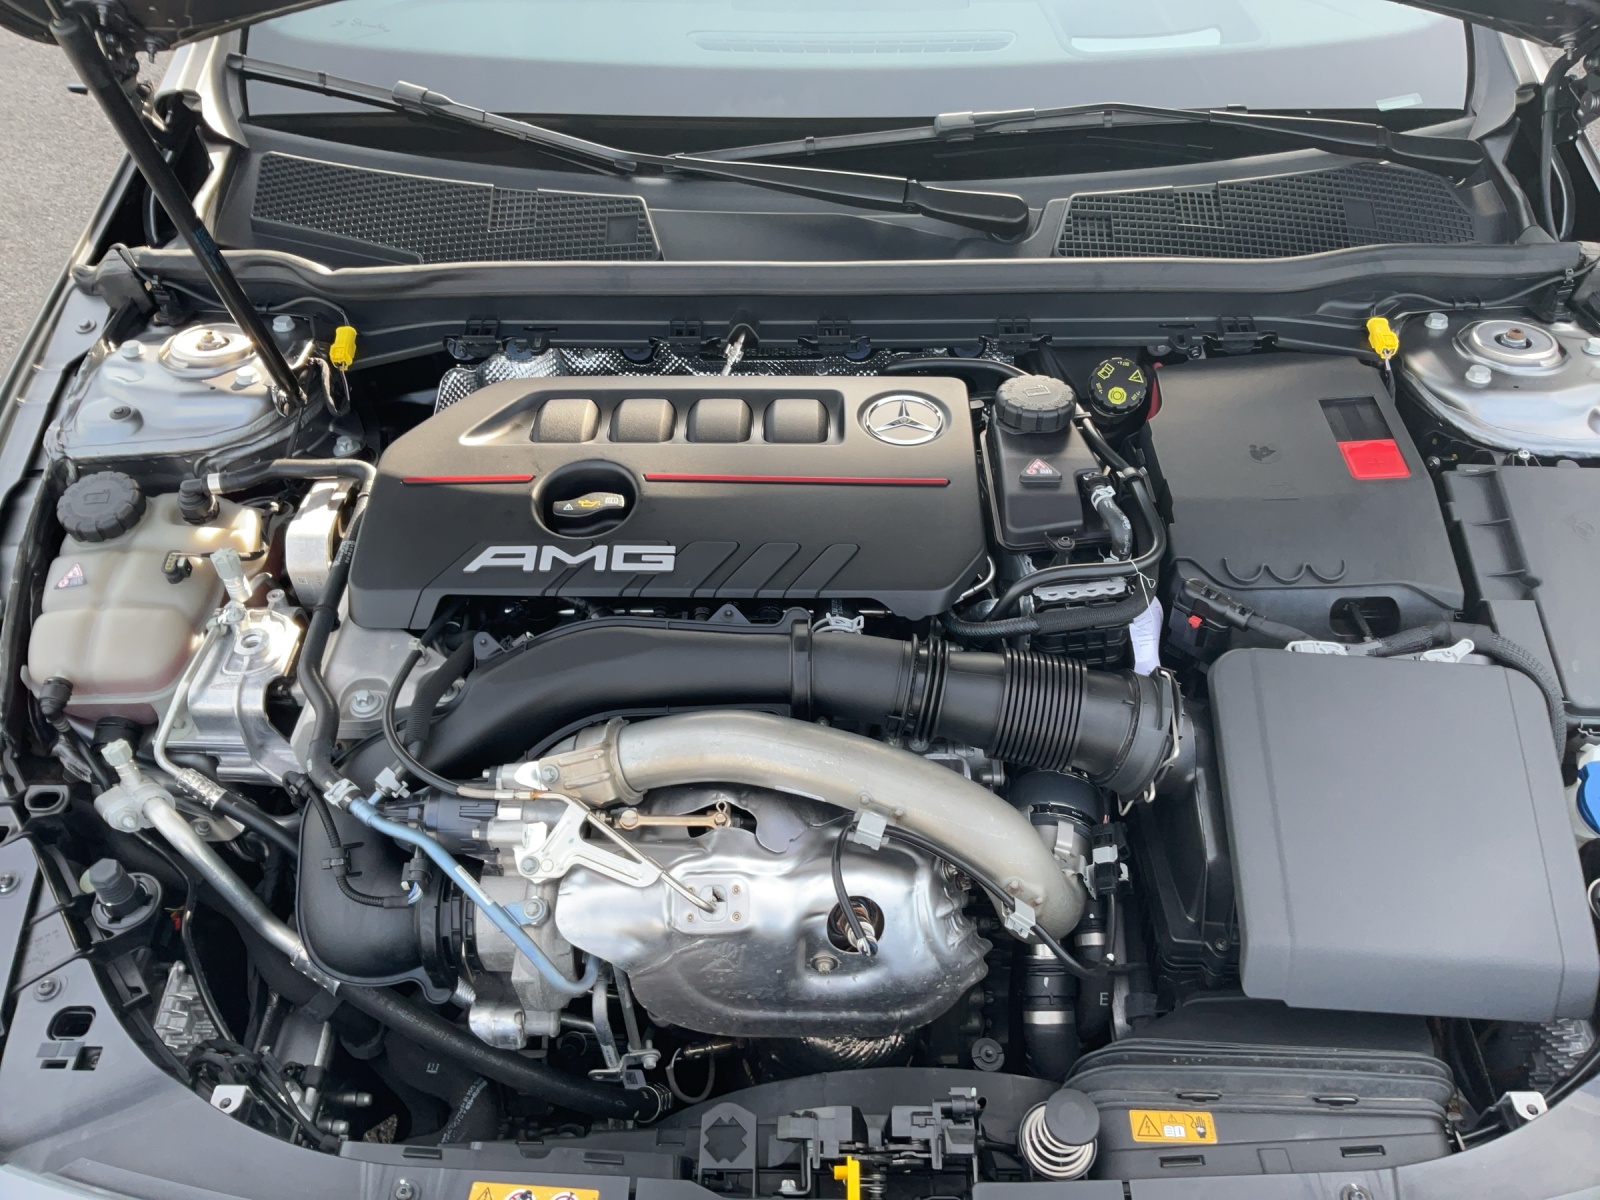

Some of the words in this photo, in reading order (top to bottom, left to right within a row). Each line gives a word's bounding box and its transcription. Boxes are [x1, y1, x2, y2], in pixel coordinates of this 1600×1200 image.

[462, 545, 677, 573] AMG
[1099, 992, 1109, 1006] E
[426, 1062, 440, 1074] E
